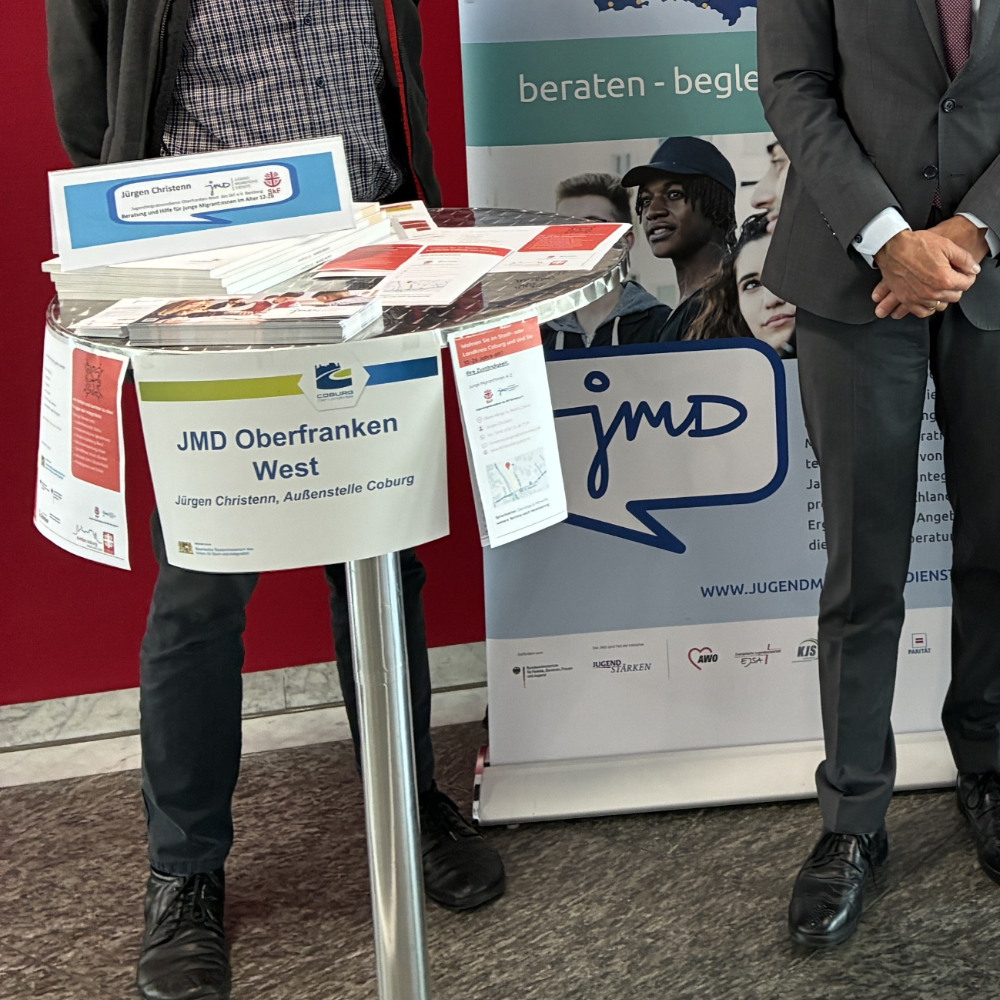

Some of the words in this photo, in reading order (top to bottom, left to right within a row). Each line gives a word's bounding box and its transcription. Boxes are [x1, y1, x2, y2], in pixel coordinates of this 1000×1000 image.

[519, 73, 646, 103] beraten
[674, 63, 759, 99] begle
[121, 188, 150, 199] Jürgen
[151, 182, 192, 195] Christenn
[267, 187, 281, 195] SkF
[121, 209, 147, 220] Beratung
[148, 208, 159, 216] und
[159, 206, 173, 214] Hilfe
[182, 204, 198, 213] junge
[316, 389, 354, 399] COBURG
[177, 430, 227, 451] JMD
[235, 416, 398, 449] Oberfranken
[920, 453, 942, 461] von
[252, 457, 319, 481] West
[175, 494, 212, 508] Jürgen
[215, 493, 280, 506] Christenn,
[283, 483, 362, 502] Außenstelle
[366, 474, 415, 491] Coburg
[700, 578, 825, 598] WWW.JUGENDM
[797, 645, 817, 657] KJS
[593, 659, 622, 668] JUGEND
[697, 653, 718, 664] AWO
[610, 662, 652, 674] STÄRKEN
